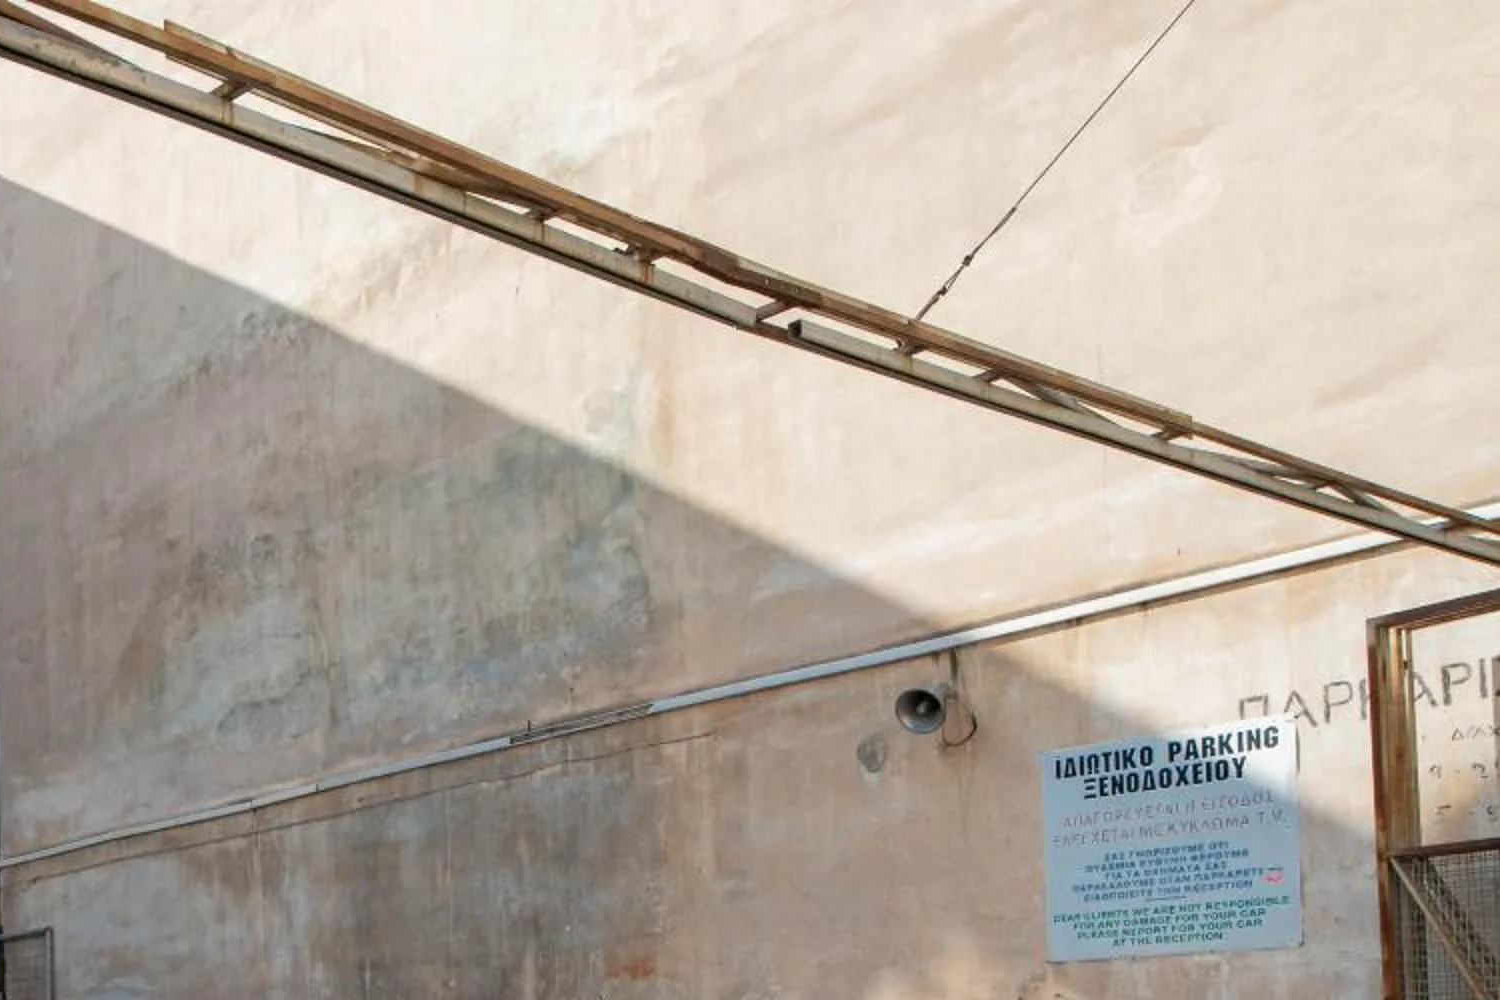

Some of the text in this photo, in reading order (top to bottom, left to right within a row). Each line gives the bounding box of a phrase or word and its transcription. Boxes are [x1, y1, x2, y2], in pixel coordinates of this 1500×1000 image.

[1056, 727, 1278, 778] ΙΔΙΩΤΙΚΟ PARKING
[1085, 758, 1245, 798] ΞΕΝΟΔΟΧΕΙΟΥ
